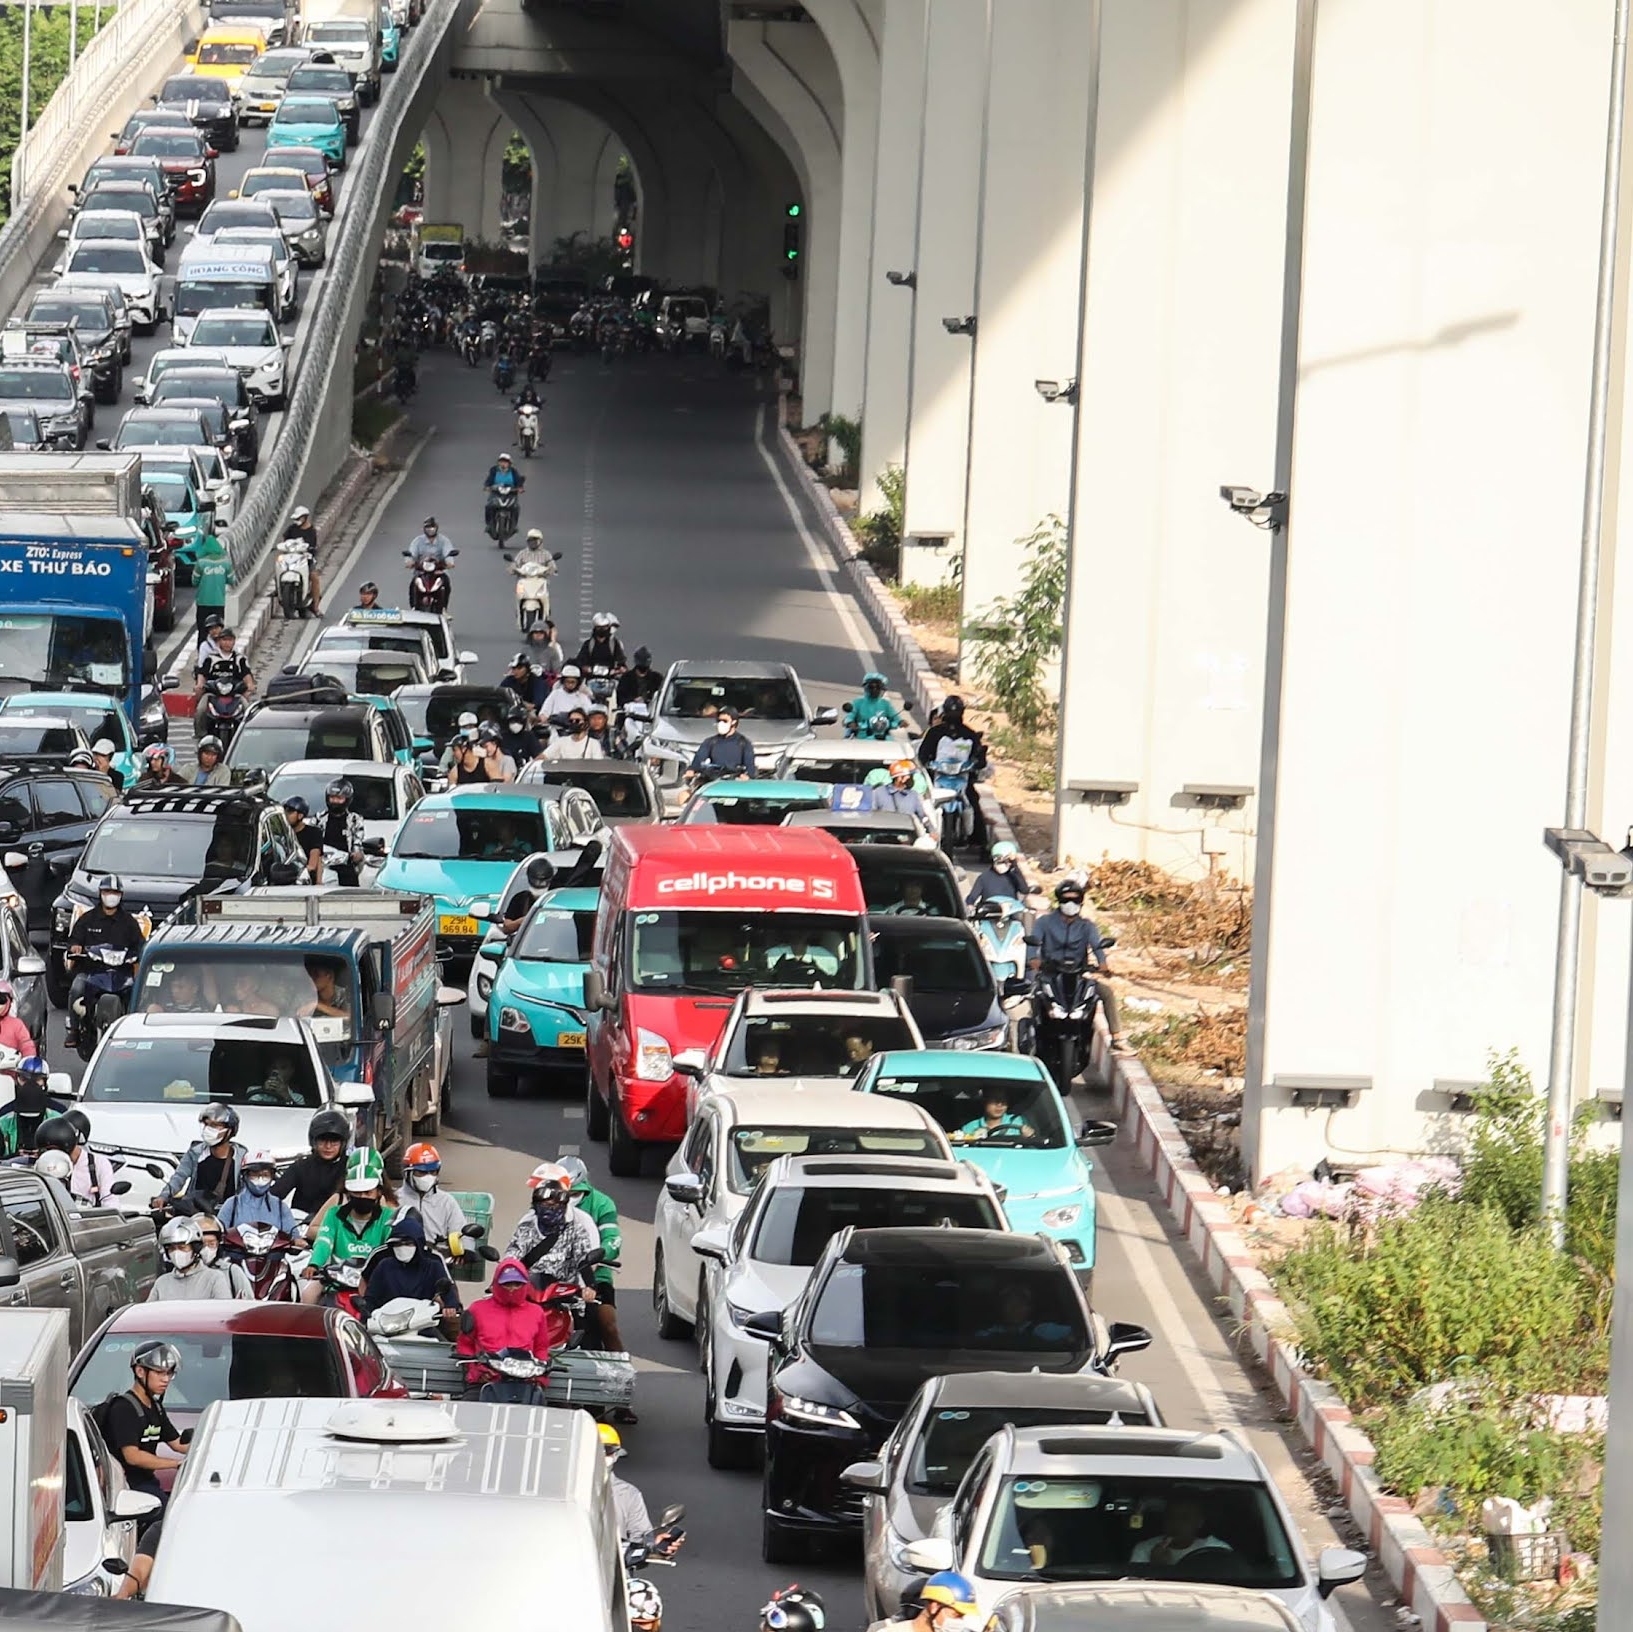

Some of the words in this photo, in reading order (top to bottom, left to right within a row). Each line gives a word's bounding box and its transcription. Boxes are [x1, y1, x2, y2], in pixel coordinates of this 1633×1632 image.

[0, 559, 24, 573] XE
[28, 560, 69, 574] THƯ
[71, 560, 111, 576] BÁO
[347, 1243, 373, 1253] Grab
